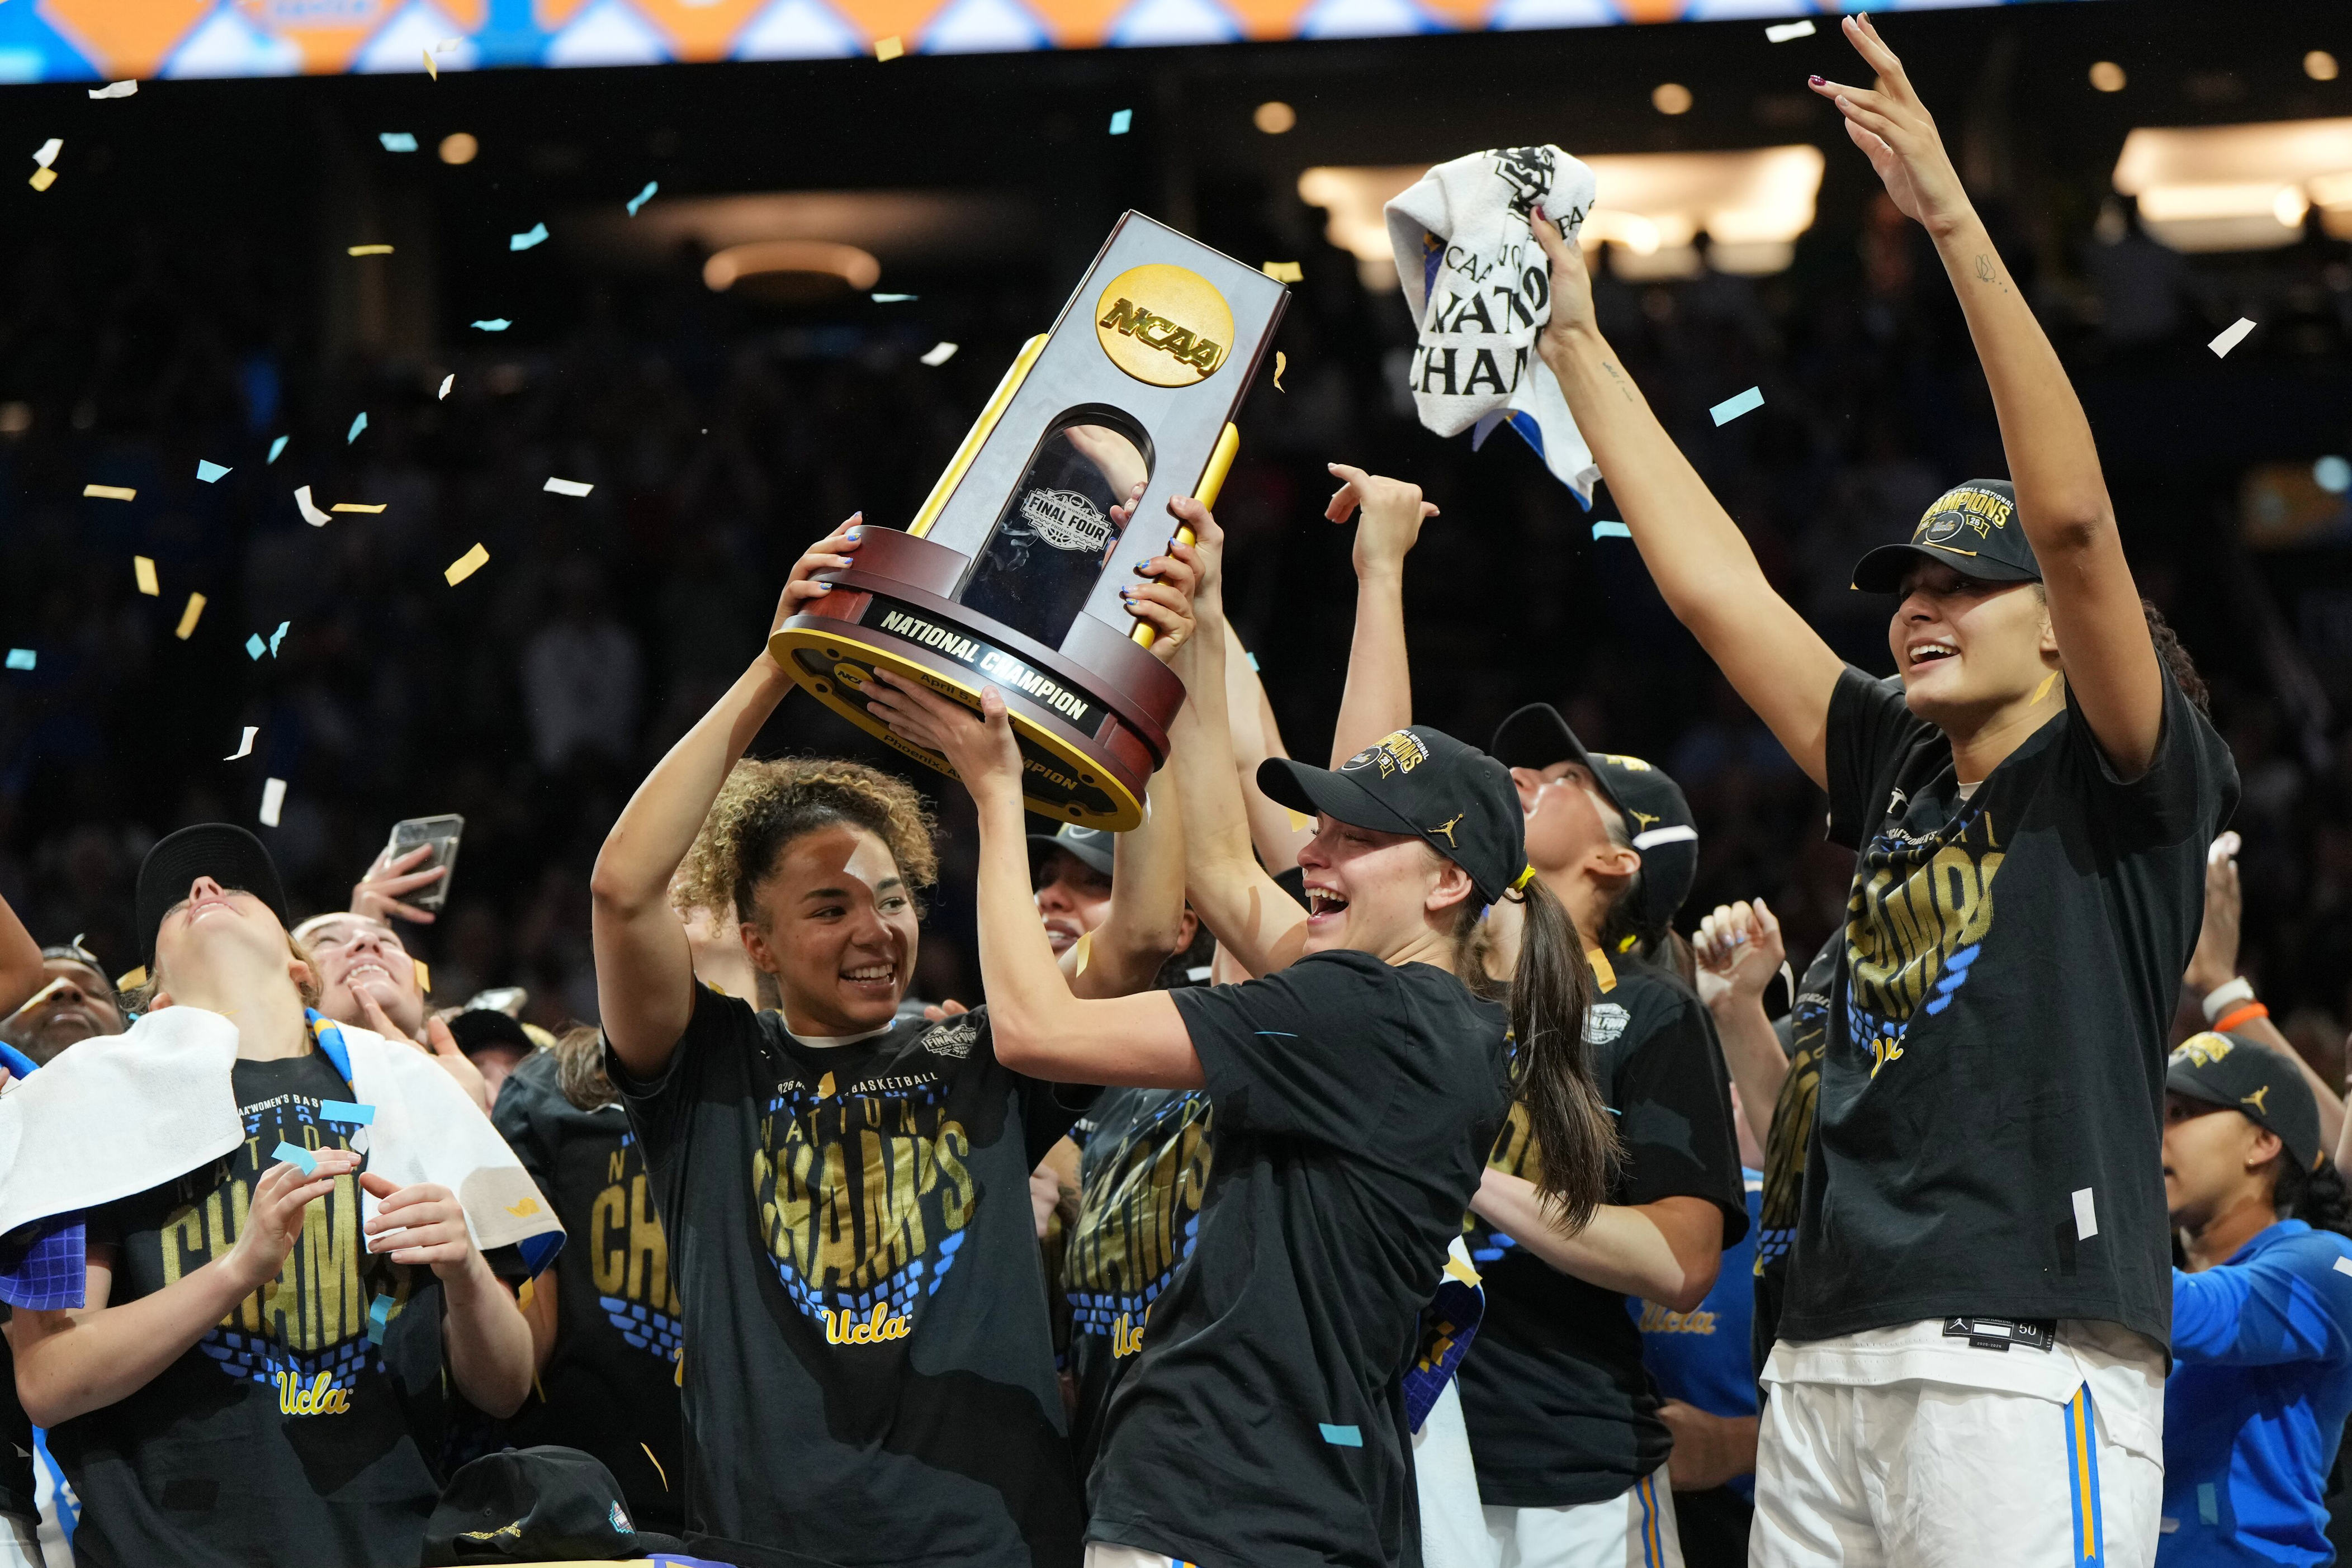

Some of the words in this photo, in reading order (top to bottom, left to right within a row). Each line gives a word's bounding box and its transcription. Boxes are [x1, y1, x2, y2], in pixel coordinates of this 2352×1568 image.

[1430, 265, 1551, 334] NATIO
[1099, 298, 1223, 378] NCAA
[1922, 492, 2011, 529] AMPIONS
[1979, 488, 2014, 510] NATIONAL
[1029, 496, 1066, 523] FINAL
[1068, 515, 1105, 541] FOUR
[1051, 523, 1072, 536] PHOENIX
[1970, 518, 1980, 526] 26
[881, 610, 979, 662] NATIONAL
[980, 652, 1089, 721] CHAMPION
[921, 674, 955, 694] April
[959, 690, 972, 703] 5,
[883, 734, 943, 771] Phoenix,
[926, 1035, 951, 1047] FINA
[851, 1072, 938, 1093] BASKETBALL
[250, 1094, 289, 1113] WOMEN'S
[293, 1094, 324, 1108] BAS
[753, 1120, 975, 1289] CHAMPS
[591, 1174, 681, 1316] CH
[821, 1302, 911, 1344] Ucla
[2019, 1323, 2037, 1335] 50
[276, 1371, 350, 1415] Ucla
